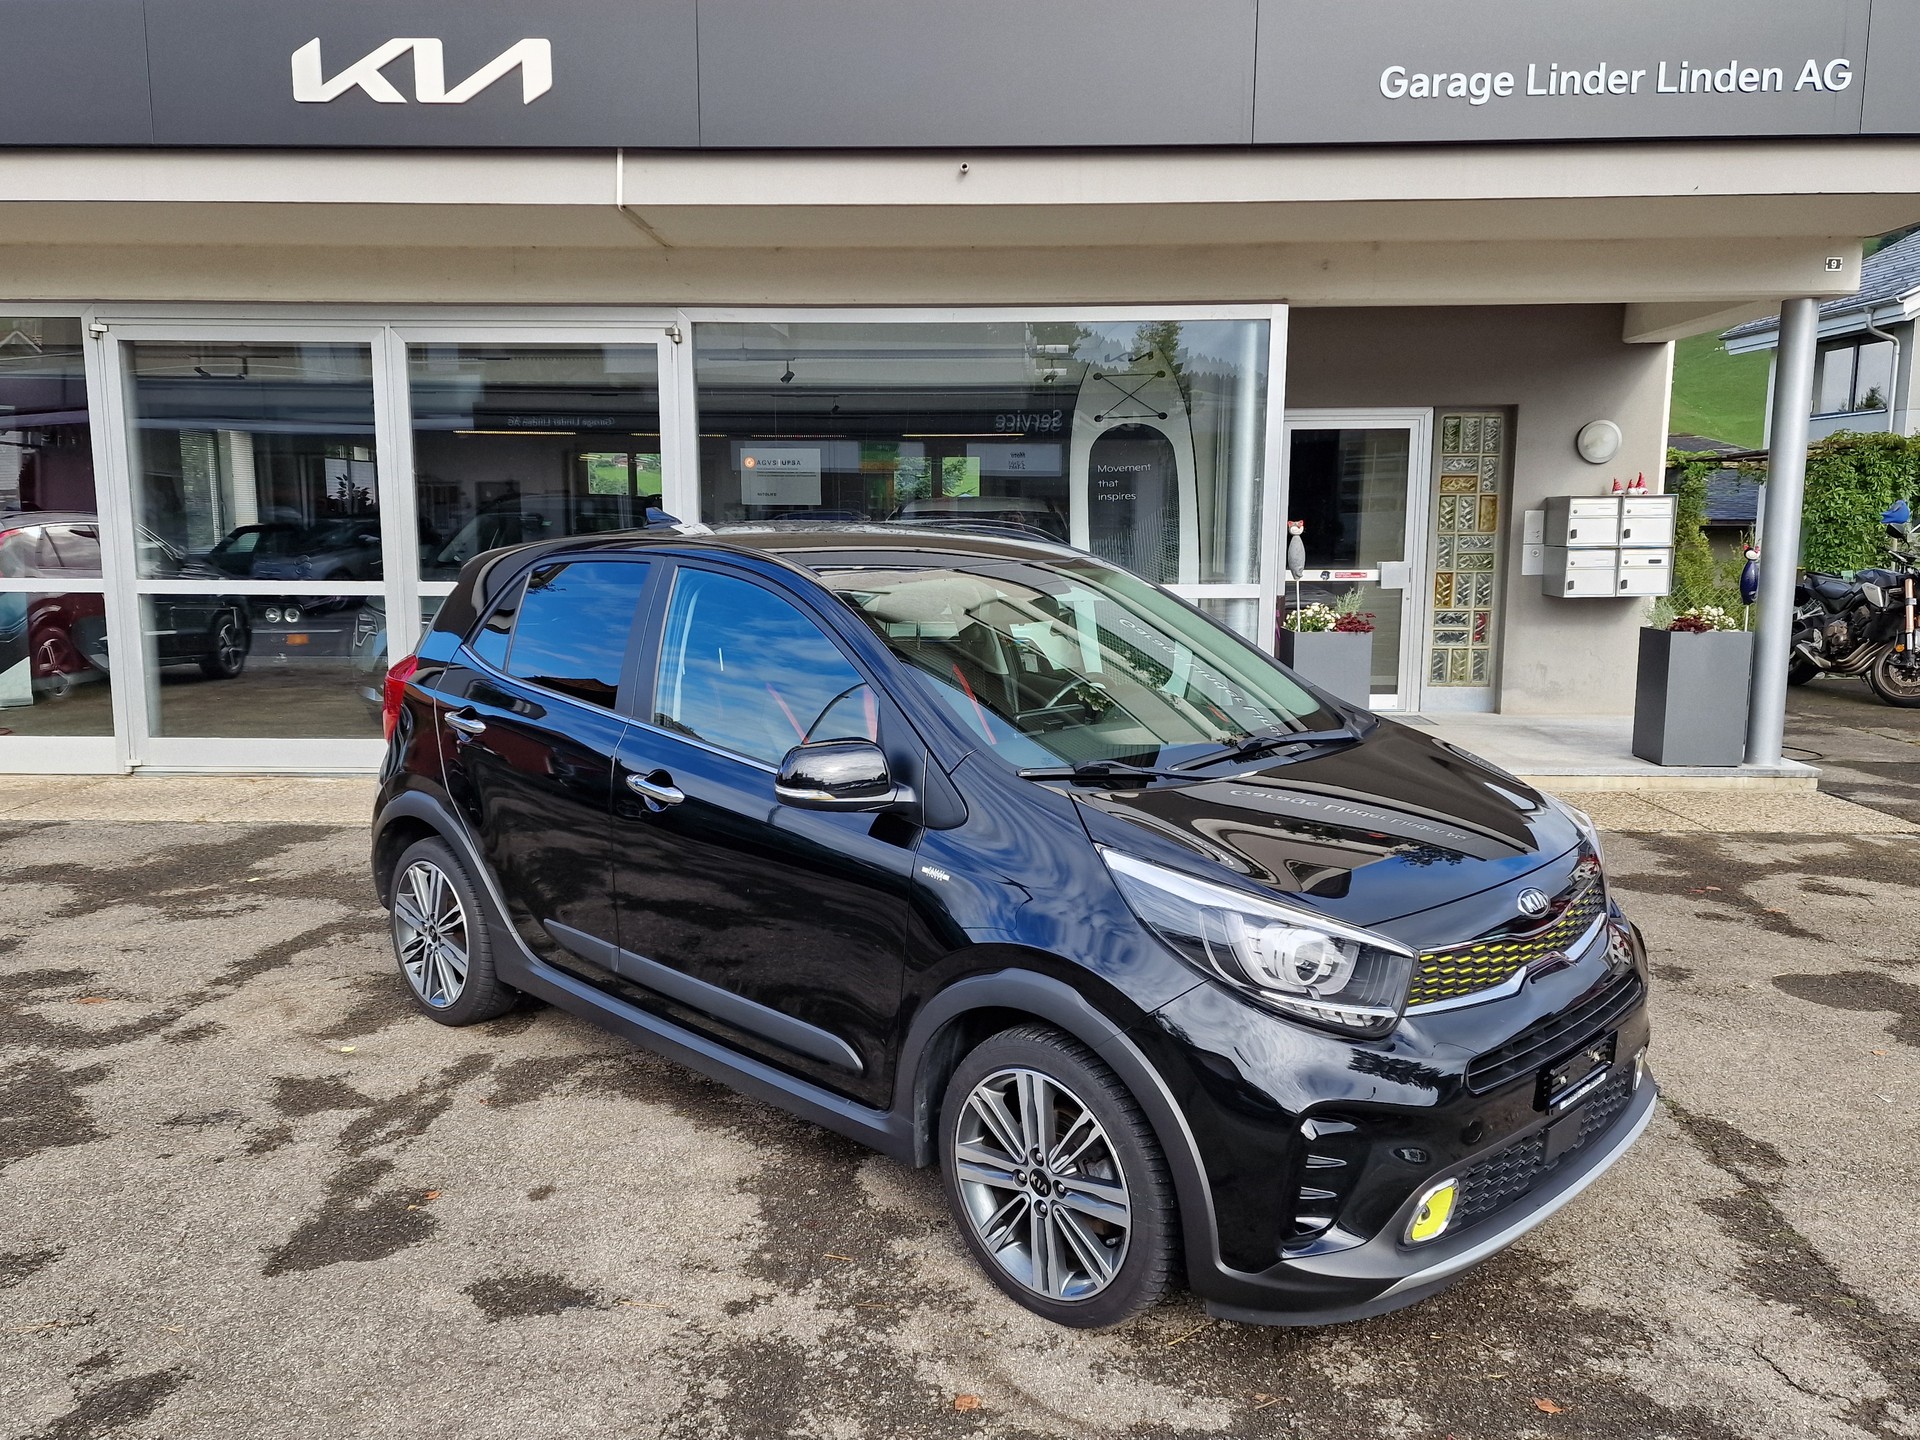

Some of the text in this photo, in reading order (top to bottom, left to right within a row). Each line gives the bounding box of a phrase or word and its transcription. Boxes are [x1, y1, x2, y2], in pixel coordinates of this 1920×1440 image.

[291, 36, 553, 105] KIA
[1379, 58, 1853, 106] Garage Linder Linden AG
[1831, 260, 1837, 269] 9
[1097, 463, 1151, 473] Movement
[1098, 480, 1119, 488] that
[1098, 492, 1137, 502] inspires
[1030, 1173, 1048, 1194] KIA
